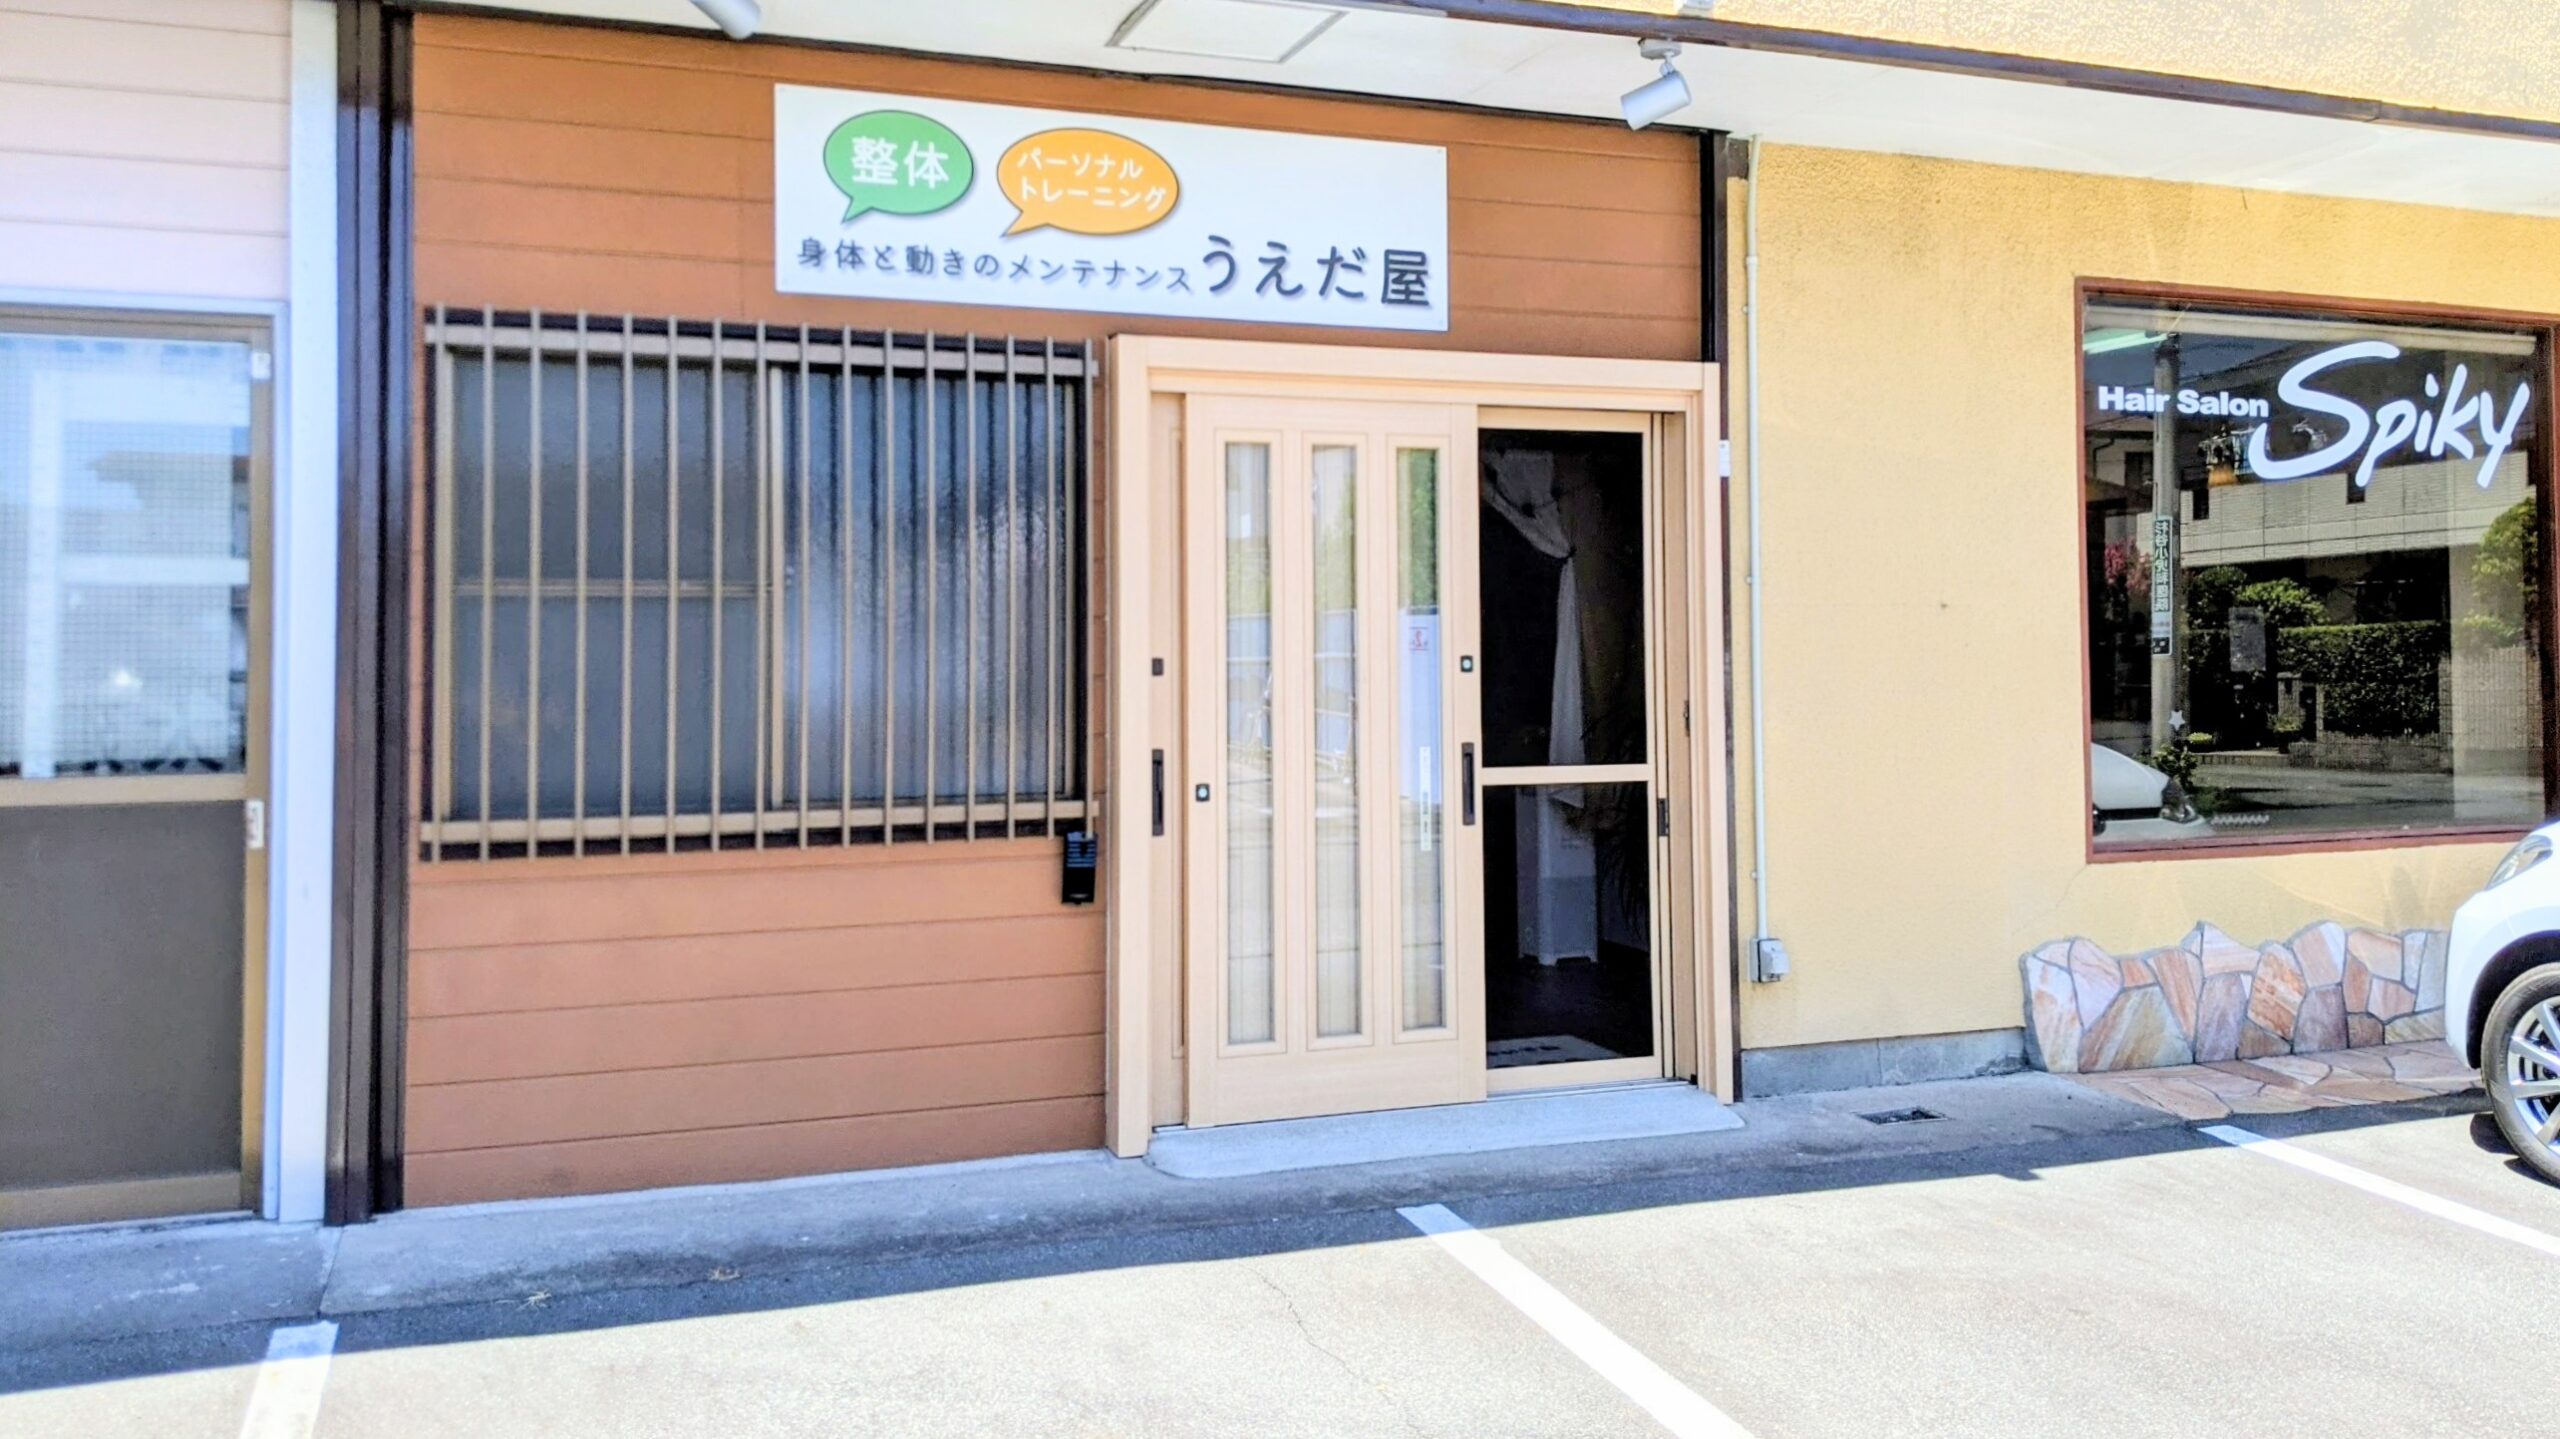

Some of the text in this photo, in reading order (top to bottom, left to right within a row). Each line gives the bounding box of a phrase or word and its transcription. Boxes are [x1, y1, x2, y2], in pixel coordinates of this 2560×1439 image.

[851, 136, 950, 189] 整体
[1017, 147, 1143, 180] パーソナル
[1021, 176, 1167, 212] トレーニング
[797, 234, 1430, 306] 身体と動きのメンテナンス うえだ屋
[2098, 341, 2530, 488] Hair Salon Spiky
